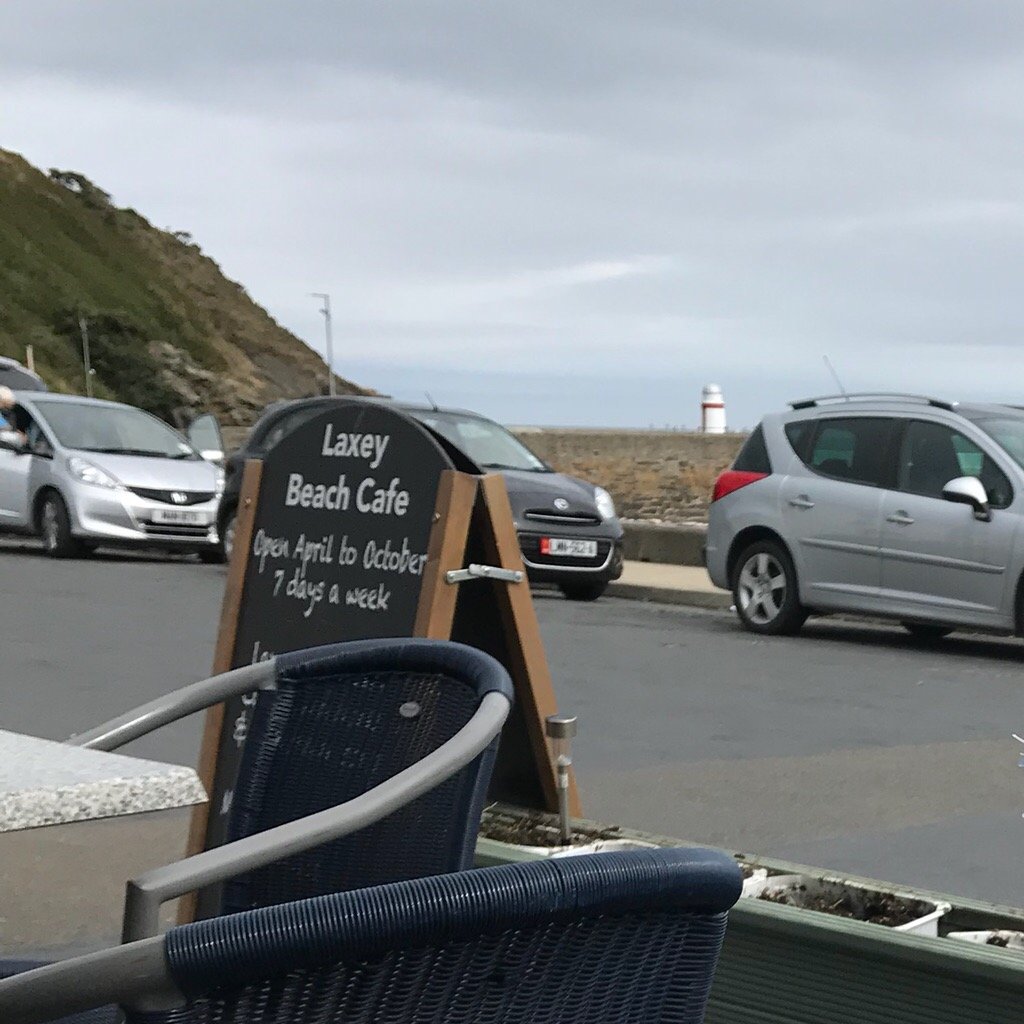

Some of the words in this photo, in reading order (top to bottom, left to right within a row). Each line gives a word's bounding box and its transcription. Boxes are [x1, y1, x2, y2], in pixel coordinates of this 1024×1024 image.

[322, 423, 390, 469] Laxey
[285, 473, 350, 511] Beach
[356, 477, 410, 516] Cafe
[253, 528, 289, 574] Open
[292, 533, 334, 579] April
[338, 535, 358, 566] to
[363, 536, 428, 576] October
[273, 569, 285, 597] 7
[286, 566, 326, 618] days
[328, 583, 340, 605] a
[345, 582, 392, 611] week
